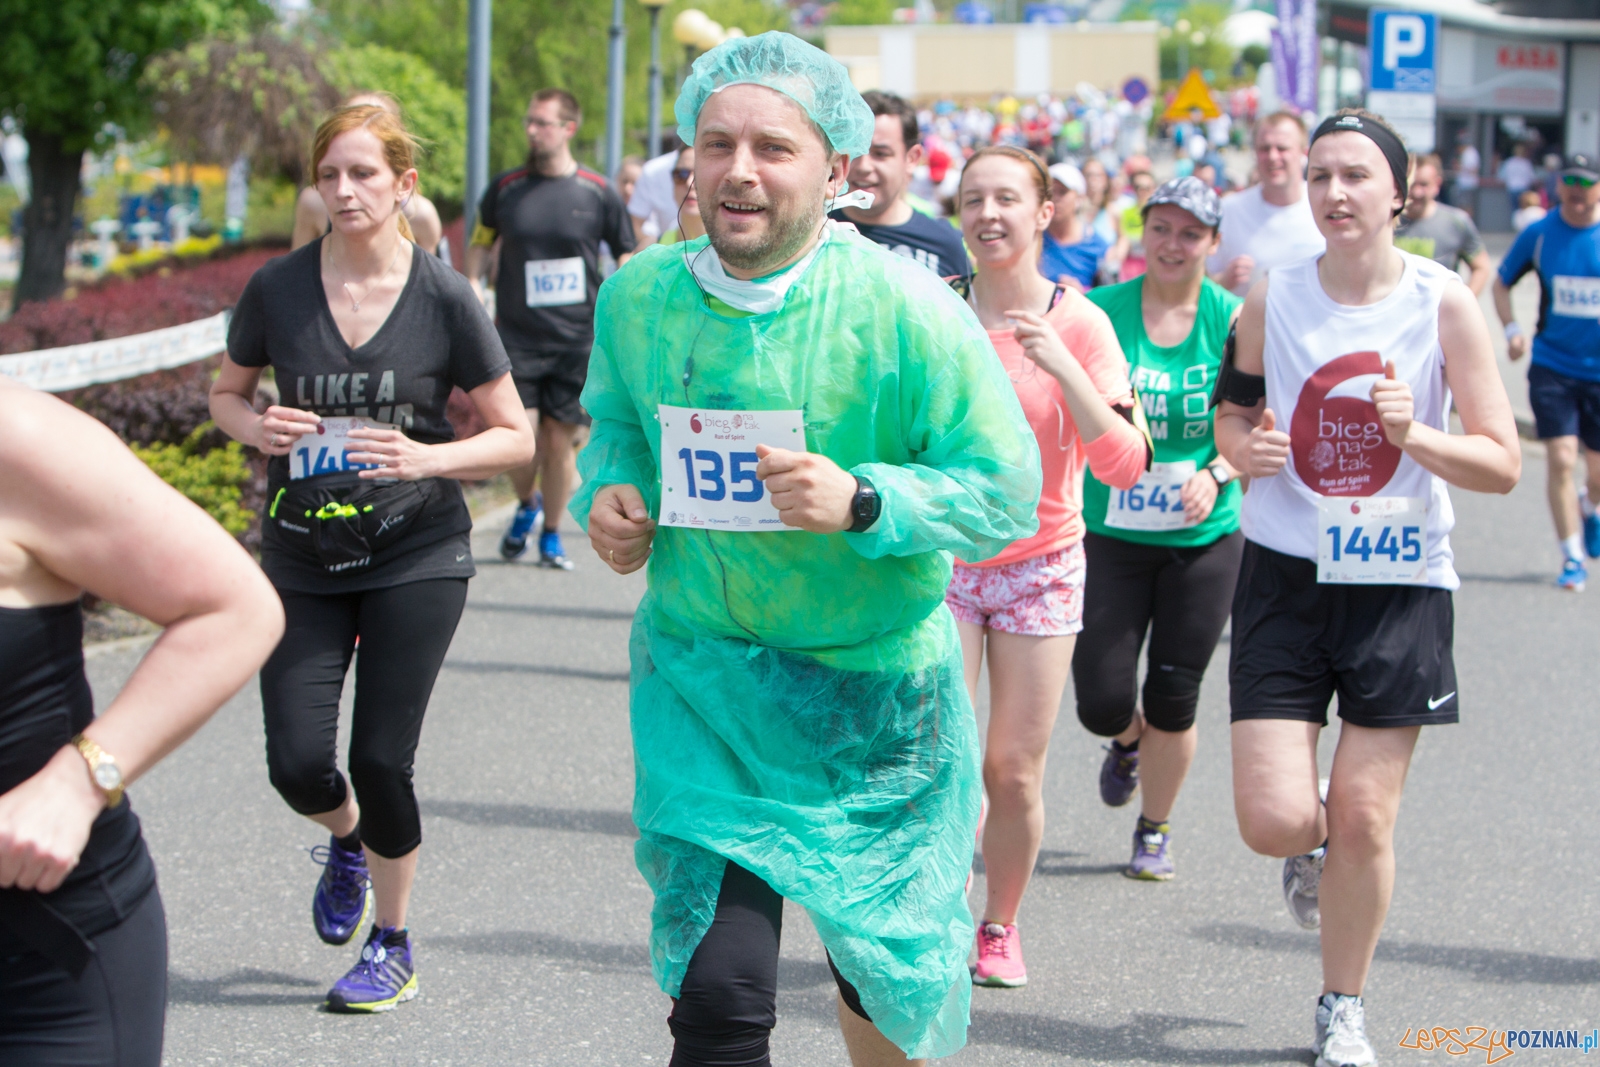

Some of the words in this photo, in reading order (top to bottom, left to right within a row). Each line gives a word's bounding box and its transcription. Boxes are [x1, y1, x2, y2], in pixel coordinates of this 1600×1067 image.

[1383, 15, 1426, 70] P
[1496, 47, 1558, 69] KASA
[533, 272, 578, 293] 1672
[297, 372, 369, 406] LIKE
[375, 370, 395, 403] A
[704, 413, 731, 434] bieg
[1318, 408, 1382, 449] bieg
[1336, 441, 1360, 454] na
[1338, 453, 1372, 472] tak
[678, 447, 764, 503] 135
[1319, 478, 1336, 487] Run
[1337, 476, 1347, 486] of
[1348, 474, 1371, 486] Spirit
[1326, 526, 1421, 562] 1445
